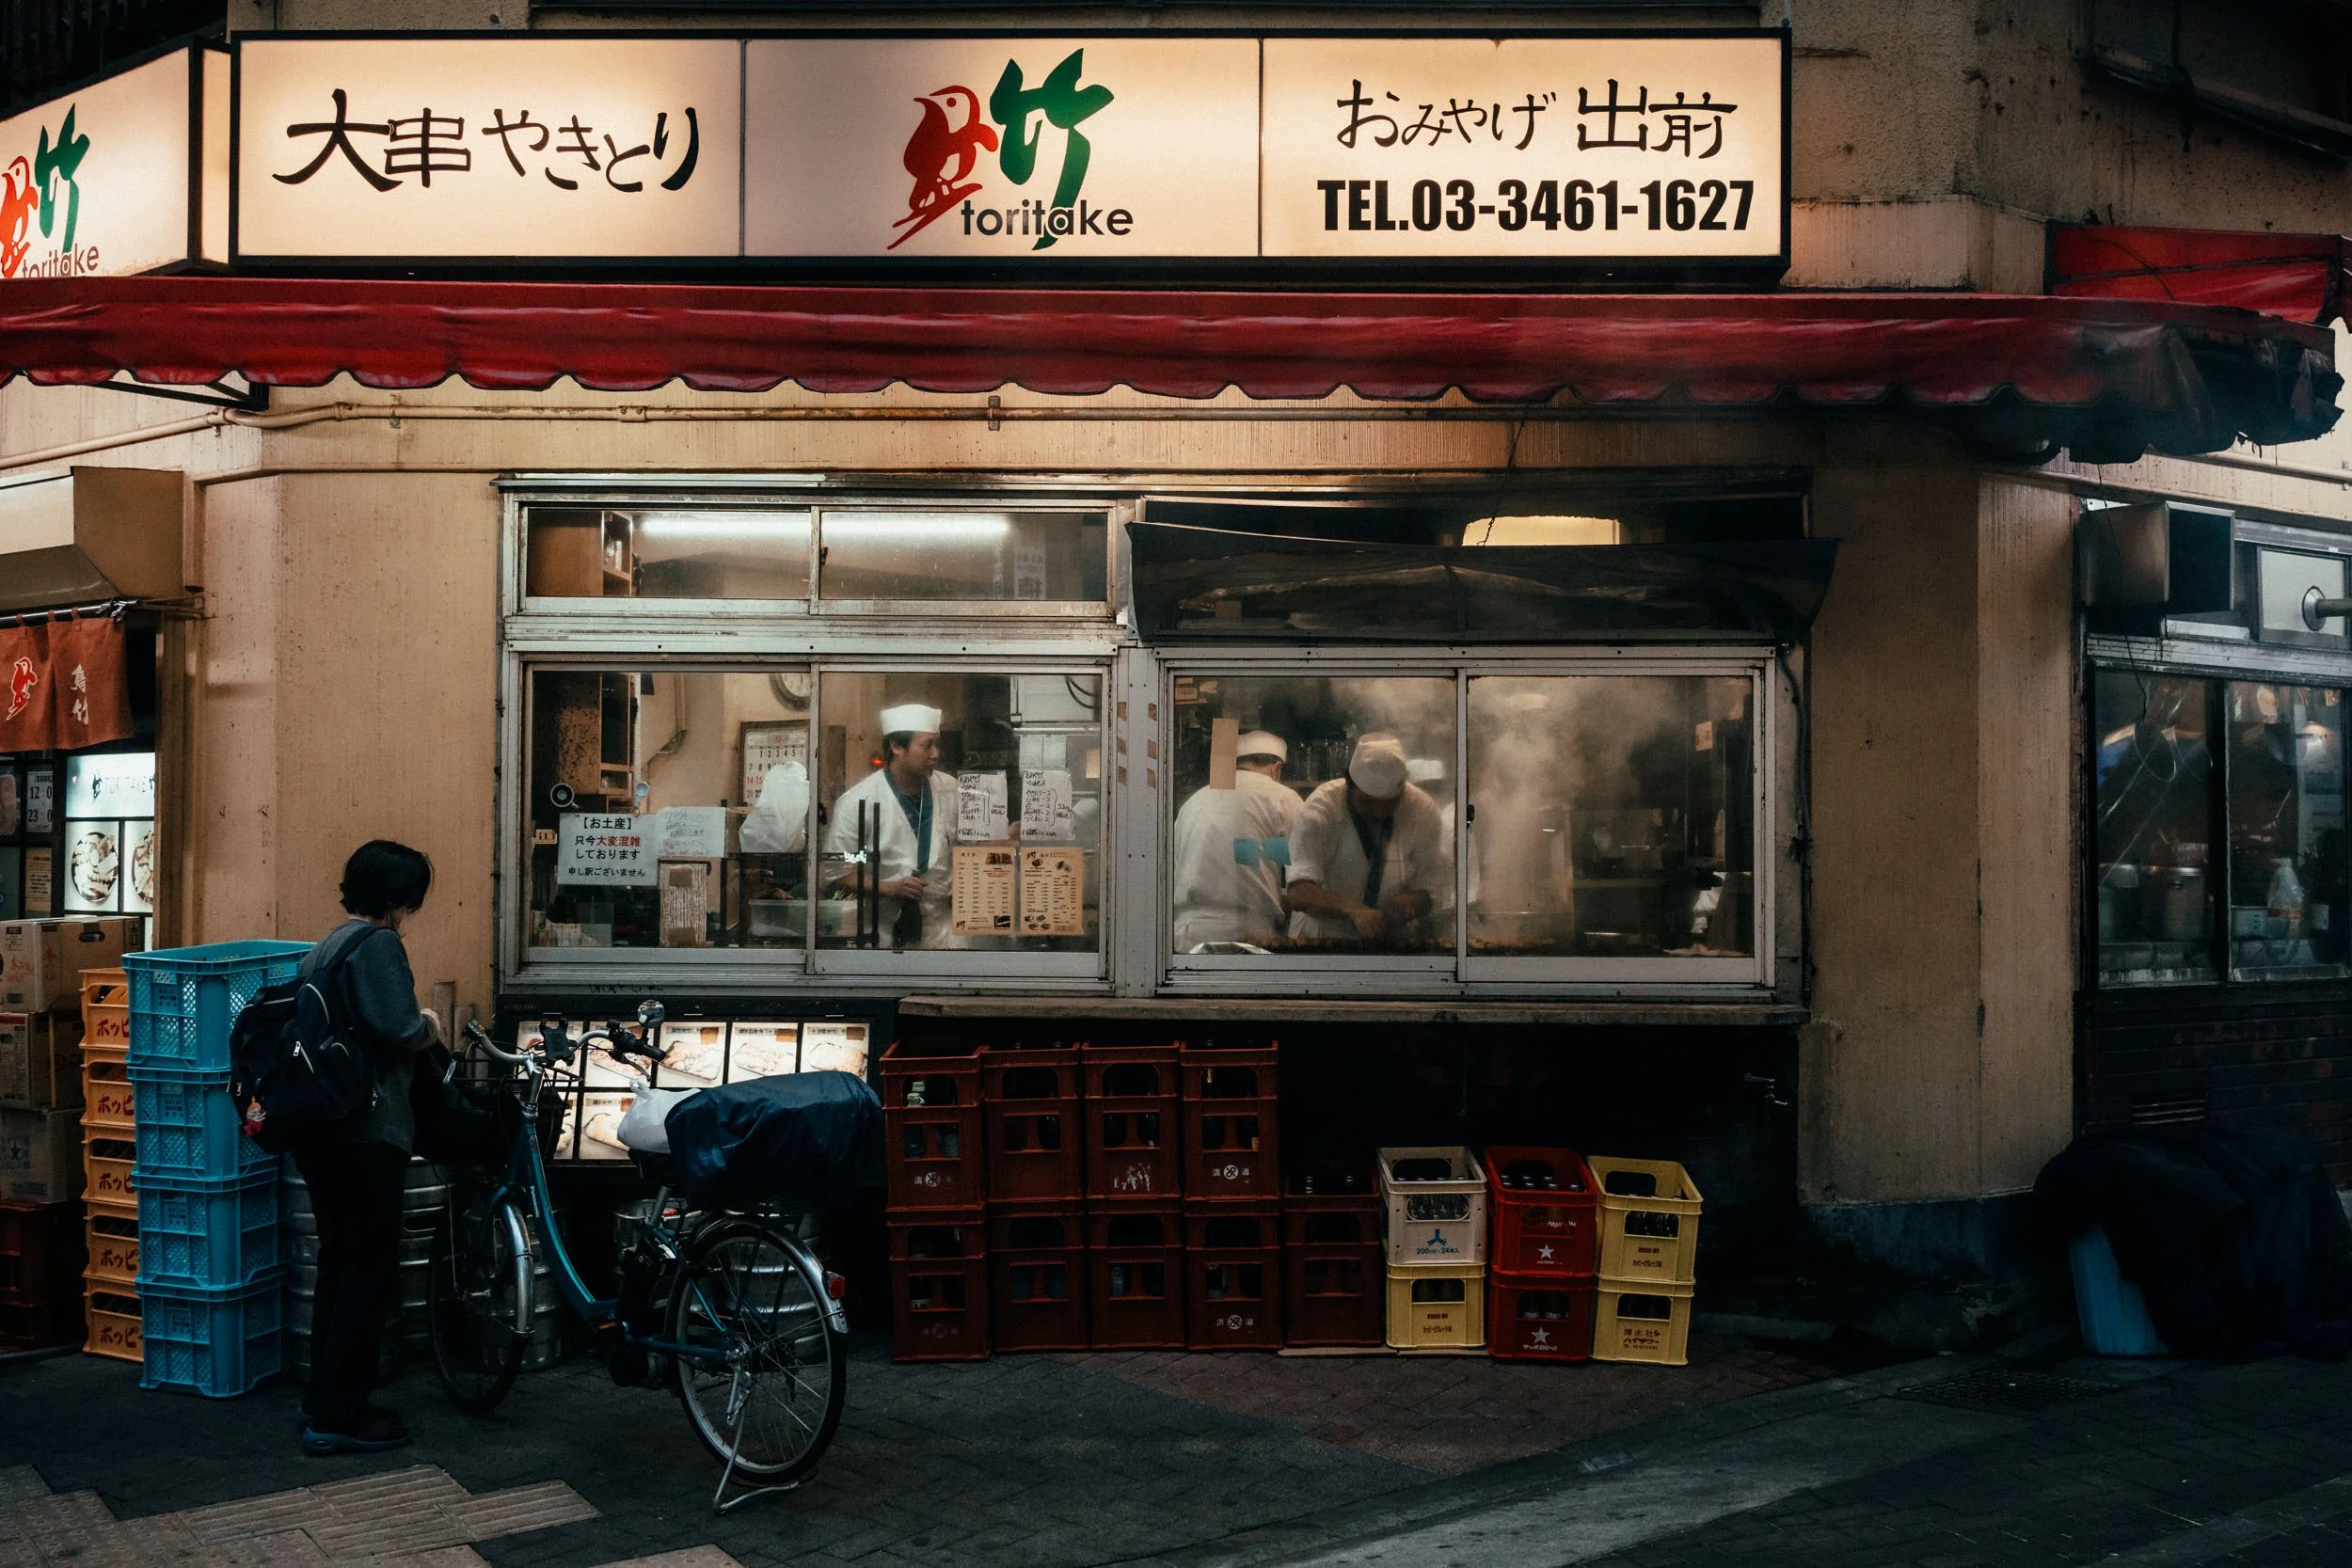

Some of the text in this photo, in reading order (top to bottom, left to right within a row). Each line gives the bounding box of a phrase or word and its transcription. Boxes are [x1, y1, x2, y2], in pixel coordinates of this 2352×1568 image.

[1336, 78, 1739, 159] おみやげ 出前
[272, 88, 700, 192] 大串やきとり
[961, 199, 1134, 236] toritake
[1317, 179, 1756, 232] TEL.03-3461-1627
[71, 663, 89, 725] 鳥竹
[583, 816, 632, 831] 【お土産】
[574, 835, 641, 847] 只今大変混雑
[576, 849, 641, 861] しております
[568, 867, 646, 878] 申し訳ございません
[530, 1185, 540, 1218] Panasonic
[101, 1248, 140, 1272] ホッピ
